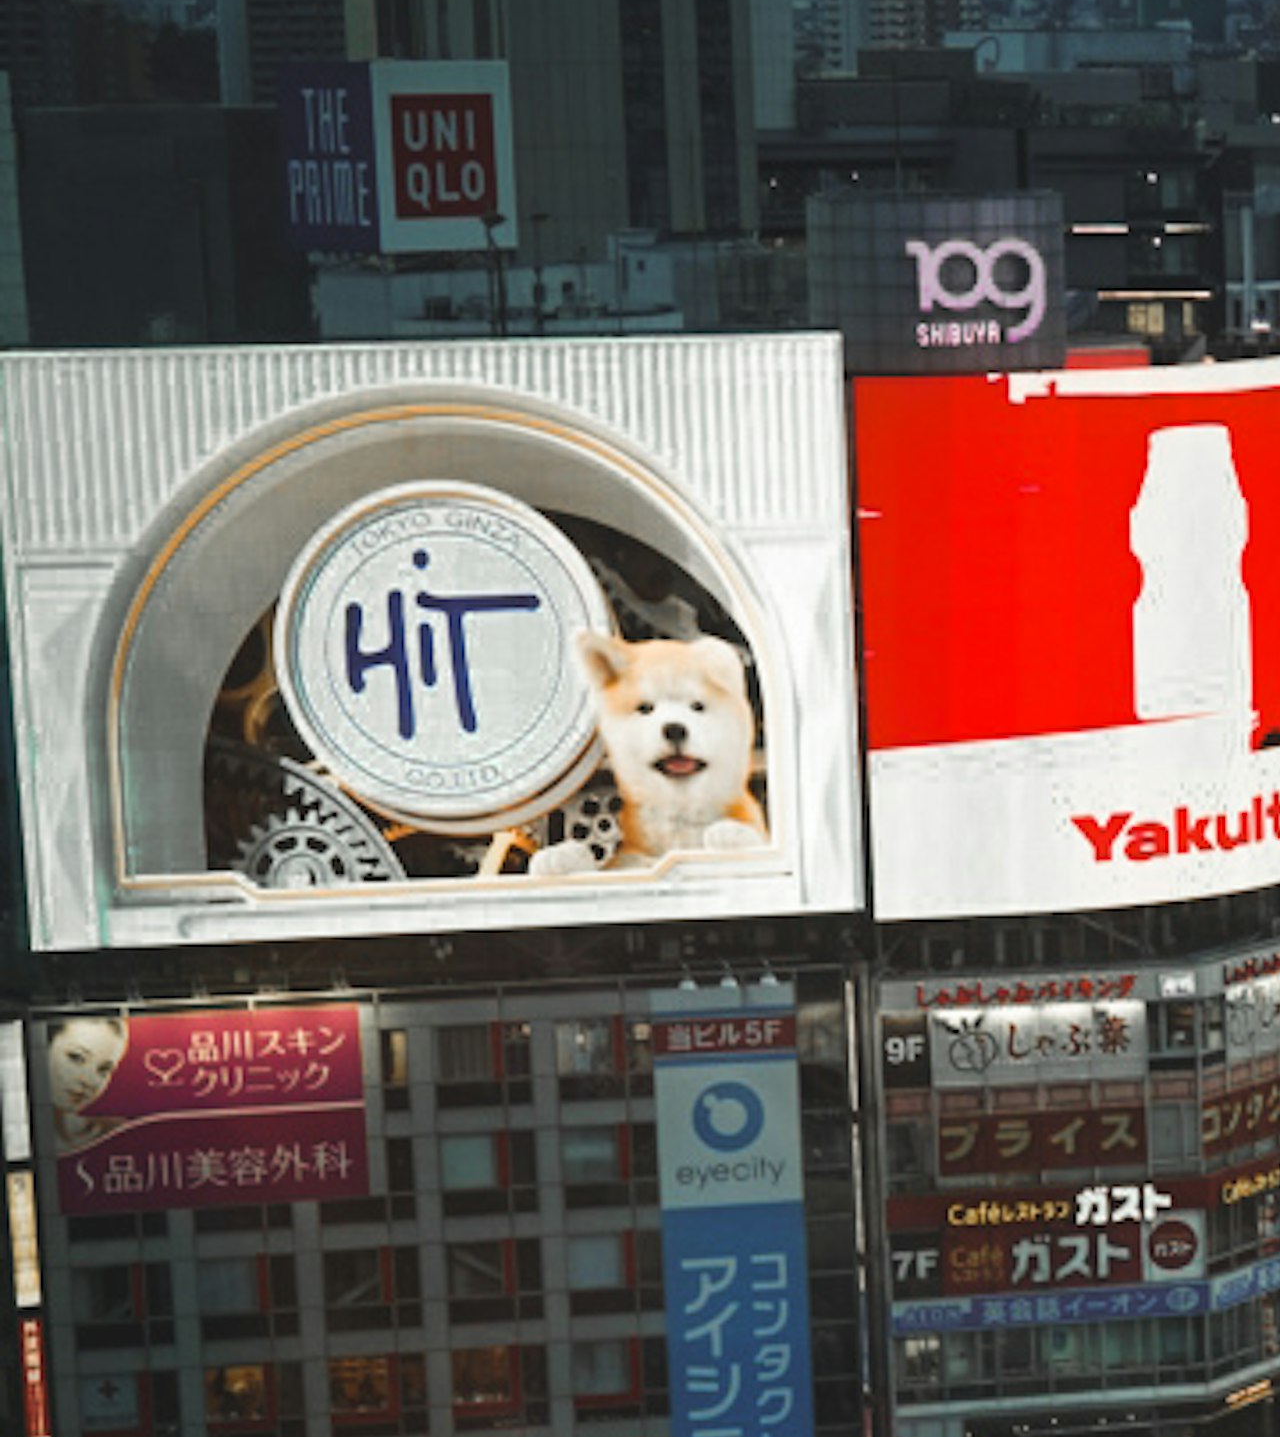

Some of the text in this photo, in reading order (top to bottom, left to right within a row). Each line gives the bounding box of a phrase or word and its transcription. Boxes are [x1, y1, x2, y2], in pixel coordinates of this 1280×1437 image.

[300, 87, 350, 156] THE
[402, 108, 477, 153] UNI
[287, 159, 372, 229] PRIME
[406, 161, 487, 211] QLO
[906, 240, 1046, 342] 109
[916, 321, 1001, 347] SHIBUYA
[186, 1027, 346, 1064] 品川スキン
[667, 1020, 784, 1050] 当ビル5F
[884, 1037, 925, 1064] 9F
[1007, 1016, 1131, 1060] しゃぶ葉
[192, 1062, 330, 1097] クリニック
[941, 1117, 1139, 1162] プライス
[104, 1140, 353, 1196] 品川美容外科
[675, 1156, 785, 1188] eyecity
[1073, 1183, 1172, 1226] ガスト
[892, 1250, 939, 1279] 7F
[1011, 1233, 1131, 1284] ガスト
[983, 1296, 1158, 1324] 英会話イーオン
